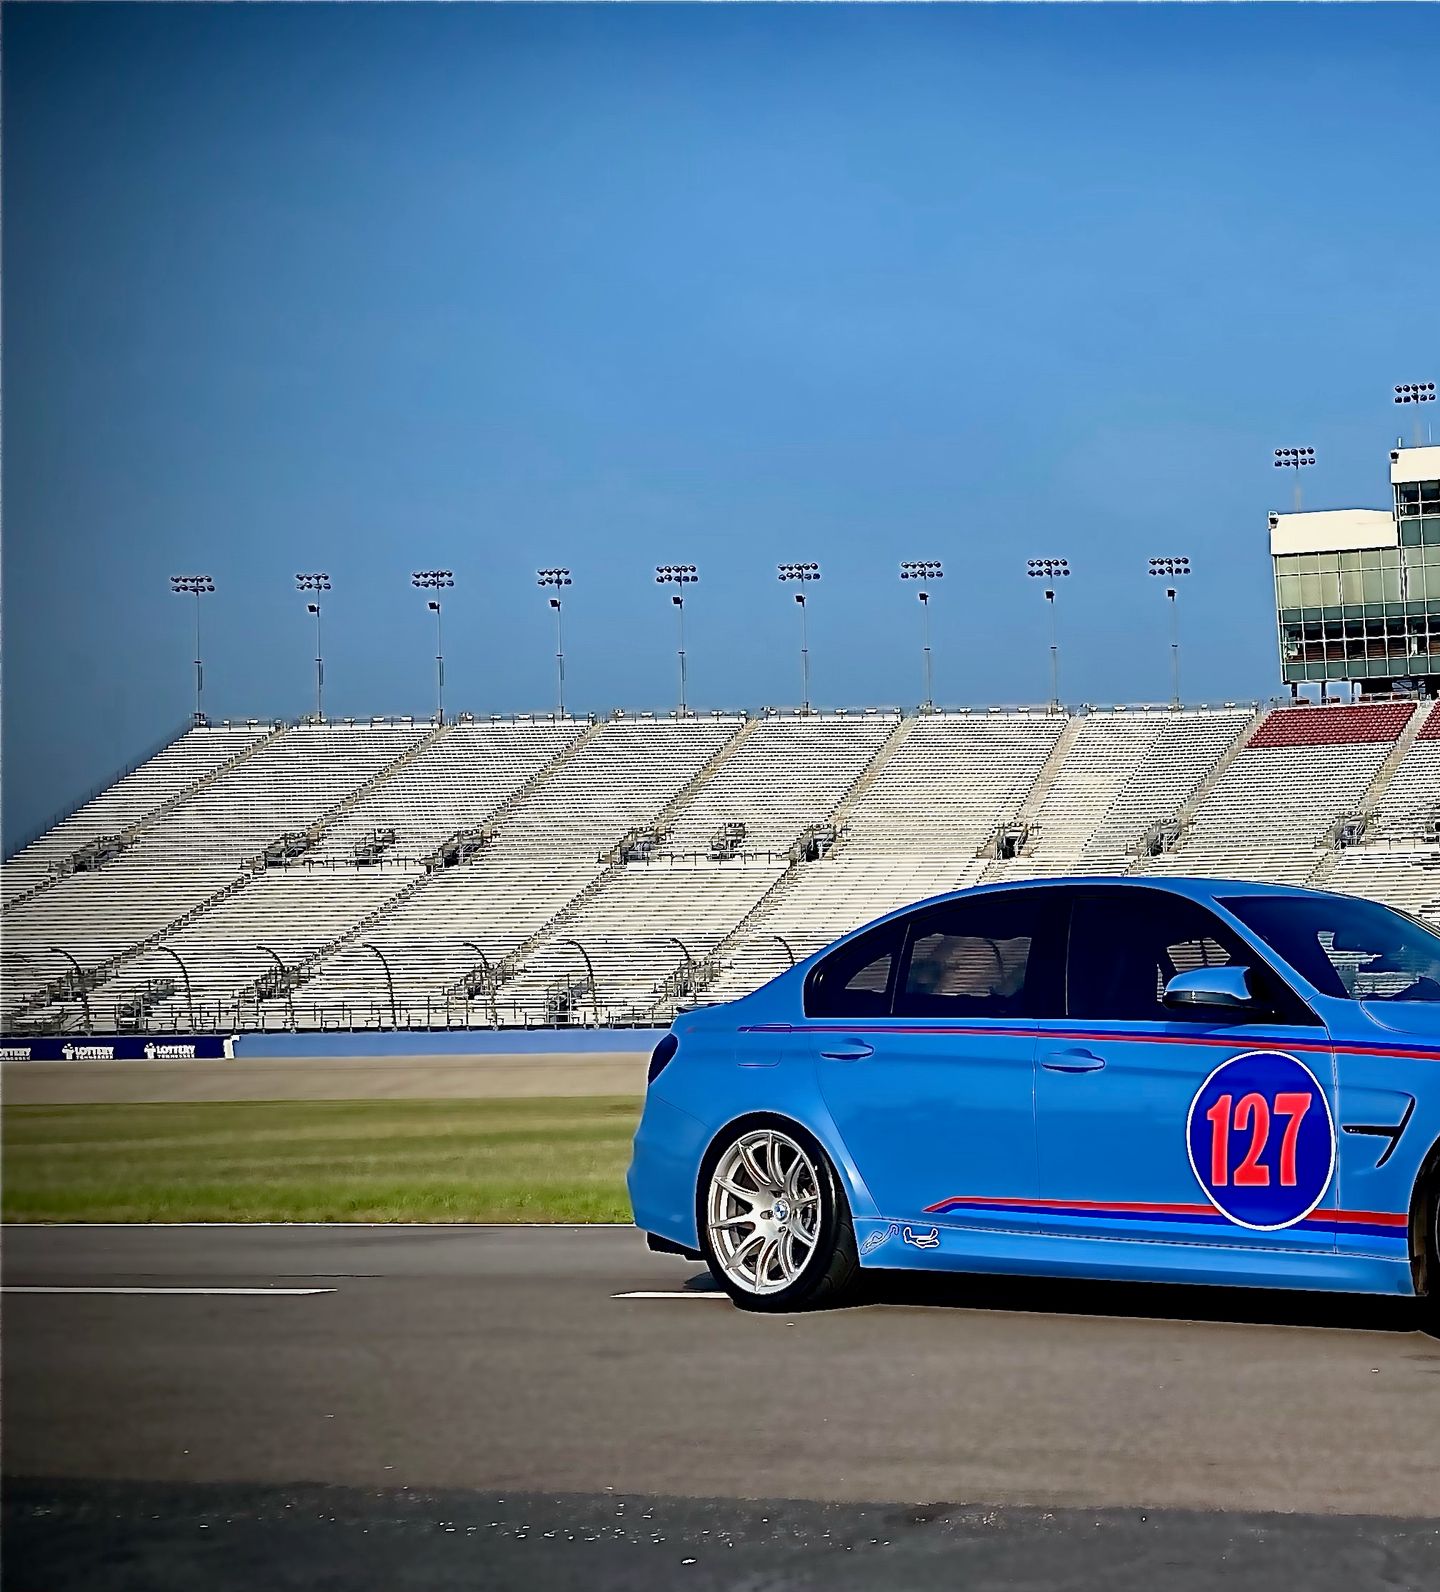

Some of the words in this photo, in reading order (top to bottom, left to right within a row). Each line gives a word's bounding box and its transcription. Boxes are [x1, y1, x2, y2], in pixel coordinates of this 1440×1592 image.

[74, 1046, 115, 1056] LOTTERY
[156, 1045, 196, 1055] LOTTERY
[1206, 1093, 1312, 1186] 127
